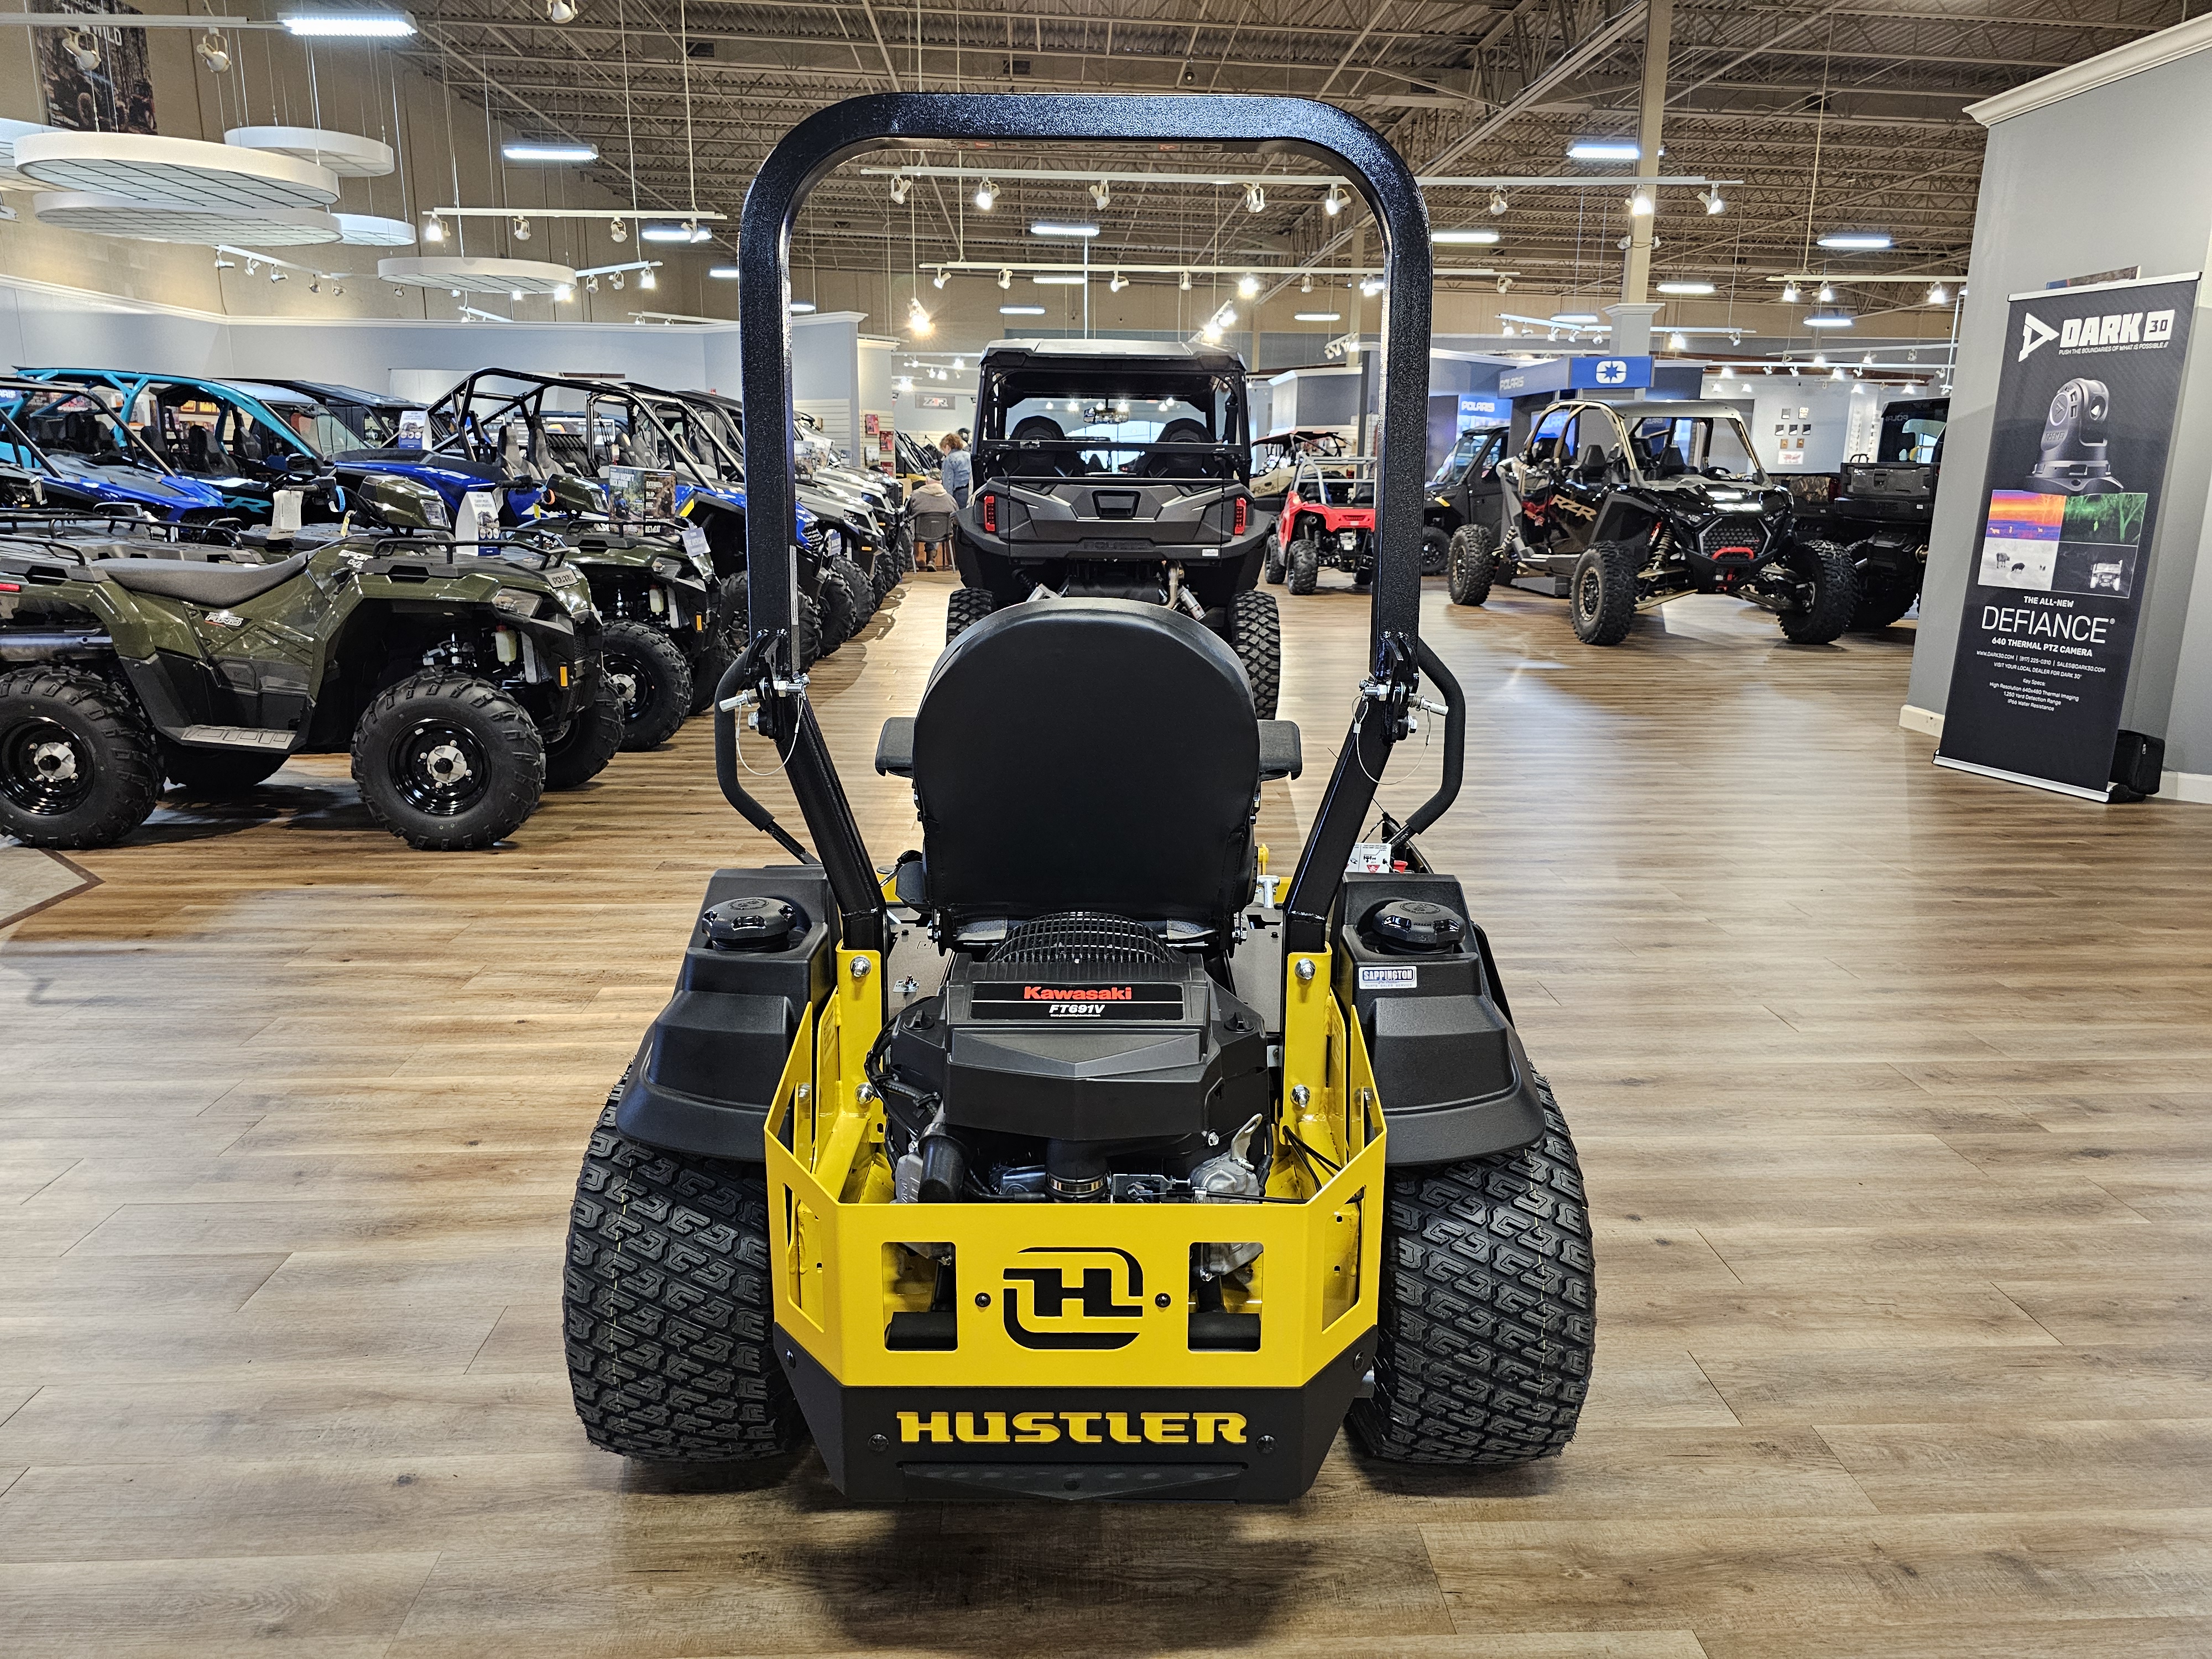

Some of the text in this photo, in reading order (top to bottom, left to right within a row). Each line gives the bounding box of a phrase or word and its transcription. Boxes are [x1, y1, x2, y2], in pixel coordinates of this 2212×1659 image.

[2060, 312, 2143, 347] DARK
[1499, 376, 1524, 390] POLARIS
[1462, 401, 1495, 412] POLARIS
[1550, 494, 1597, 521] RZR
[2039, 598, 2074, 608] ALL-NEW
[1991, 637, 2093, 657] 640 THERMAL PTZ CAMERA
[2022, 686, 2042, 695] 640x480
[2060, 693, 2079, 702] Imaging
[2031, 702, 2054, 712] Resistance
[1363, 970, 1412, 980] SAPPINGTON
[1024, 986, 1132, 1000] Kawasaki
[1048, 1004, 1105, 1013] FT691V
[896, 1412, 1247, 1443] HUSTLER
